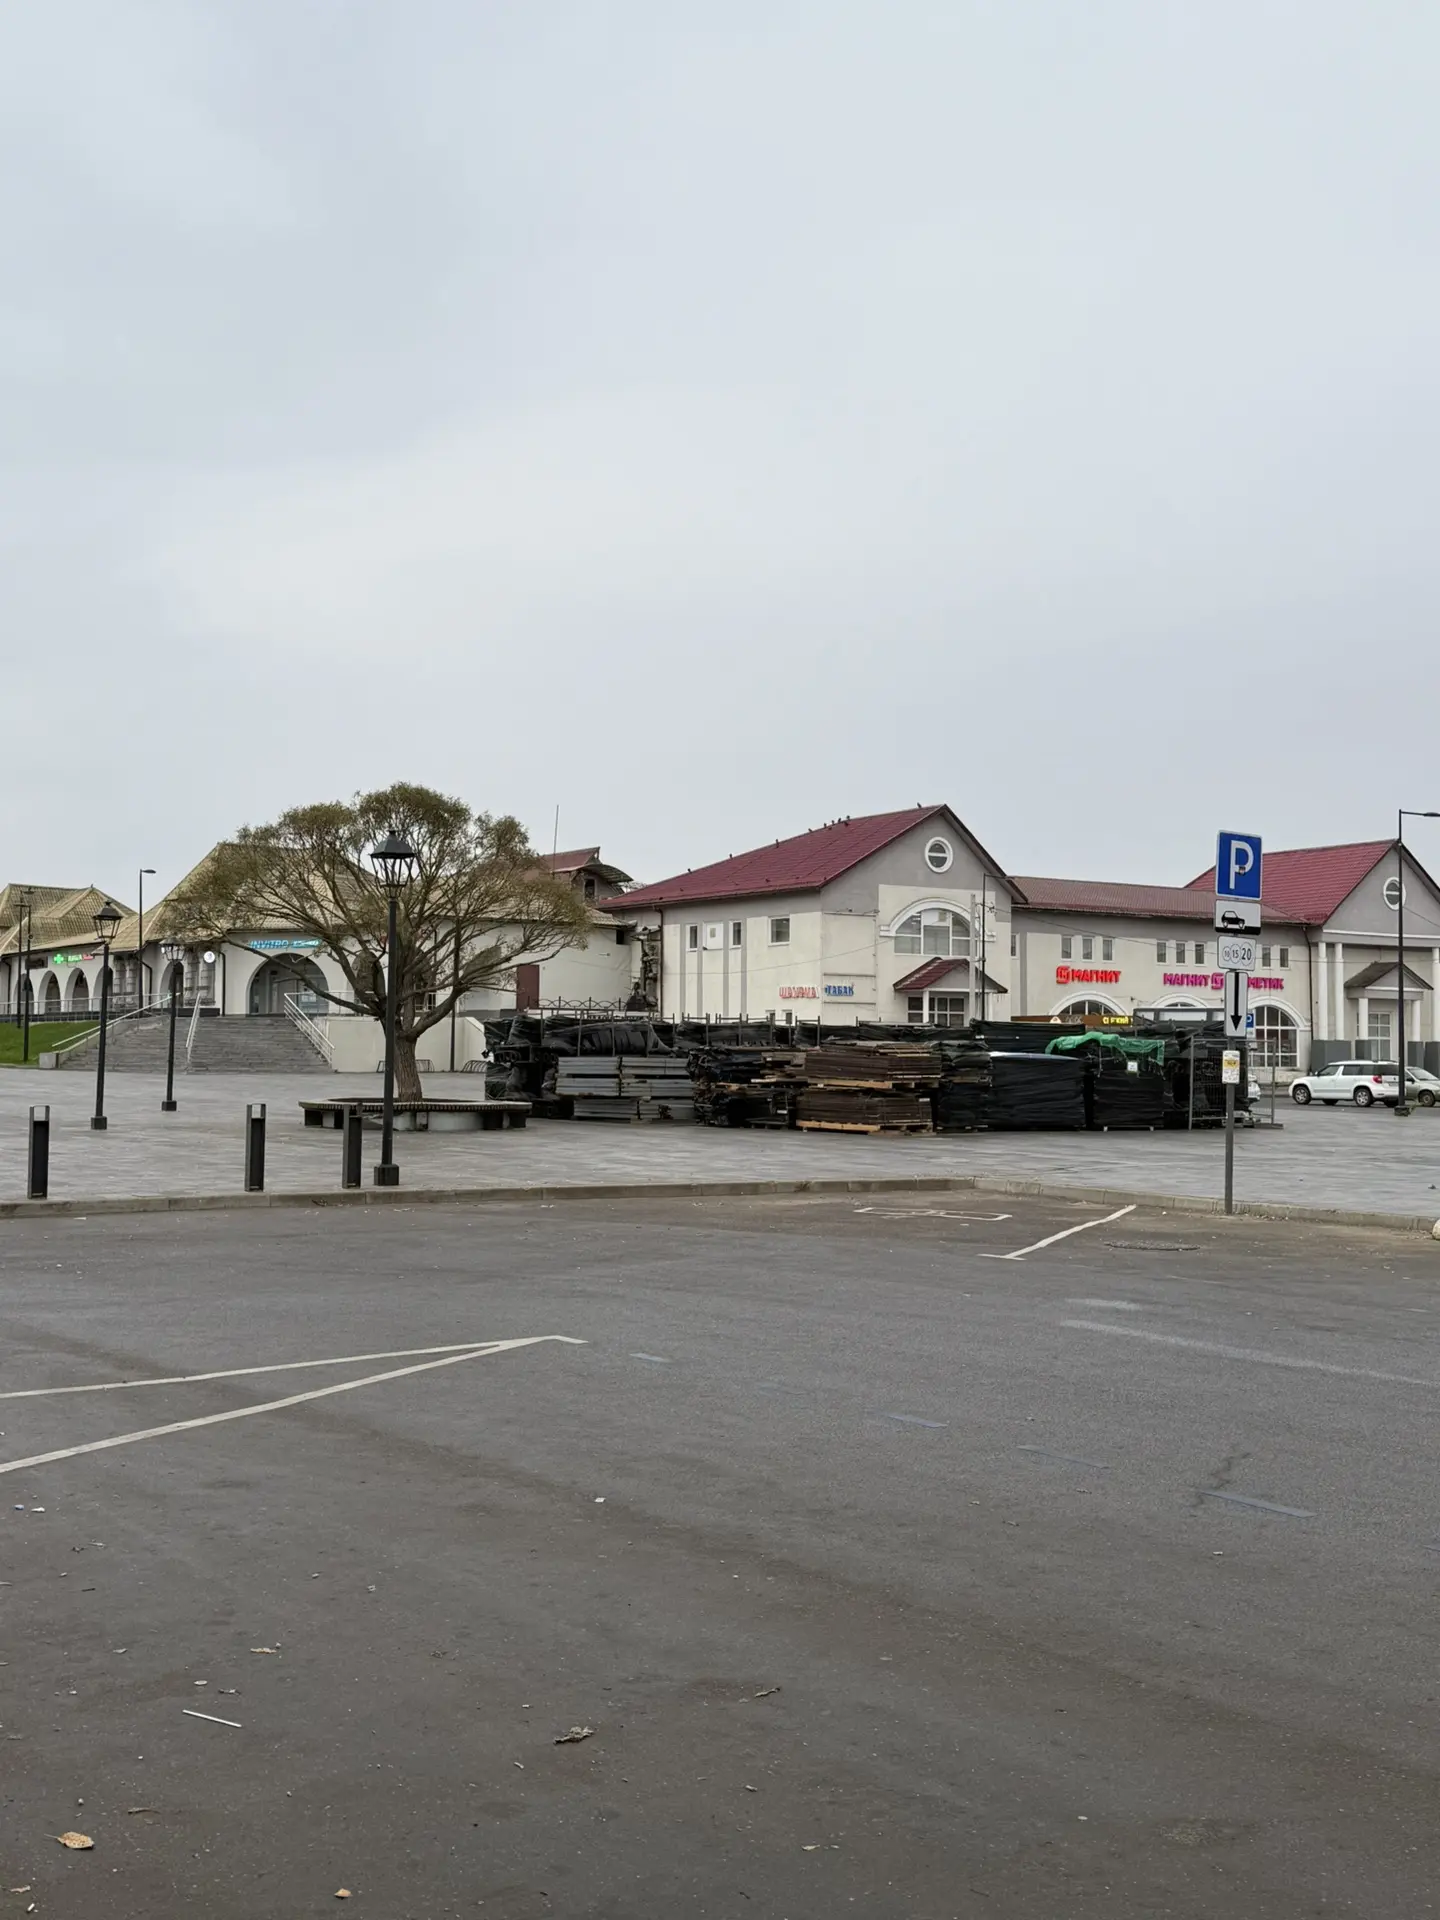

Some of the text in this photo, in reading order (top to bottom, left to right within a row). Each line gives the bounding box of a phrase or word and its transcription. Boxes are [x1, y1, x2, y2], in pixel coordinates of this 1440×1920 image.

[1229, 840, 1254, 889] P
[1232, 949, 1240, 959] 15
[1241, 948, 1252, 960] 20
[1071, 969, 1121, 983] МАГНИТ
[1163, 973, 1284, 990] МАГНИТ МЕТИК
[826, 985, 854, 996] ТАБАК
